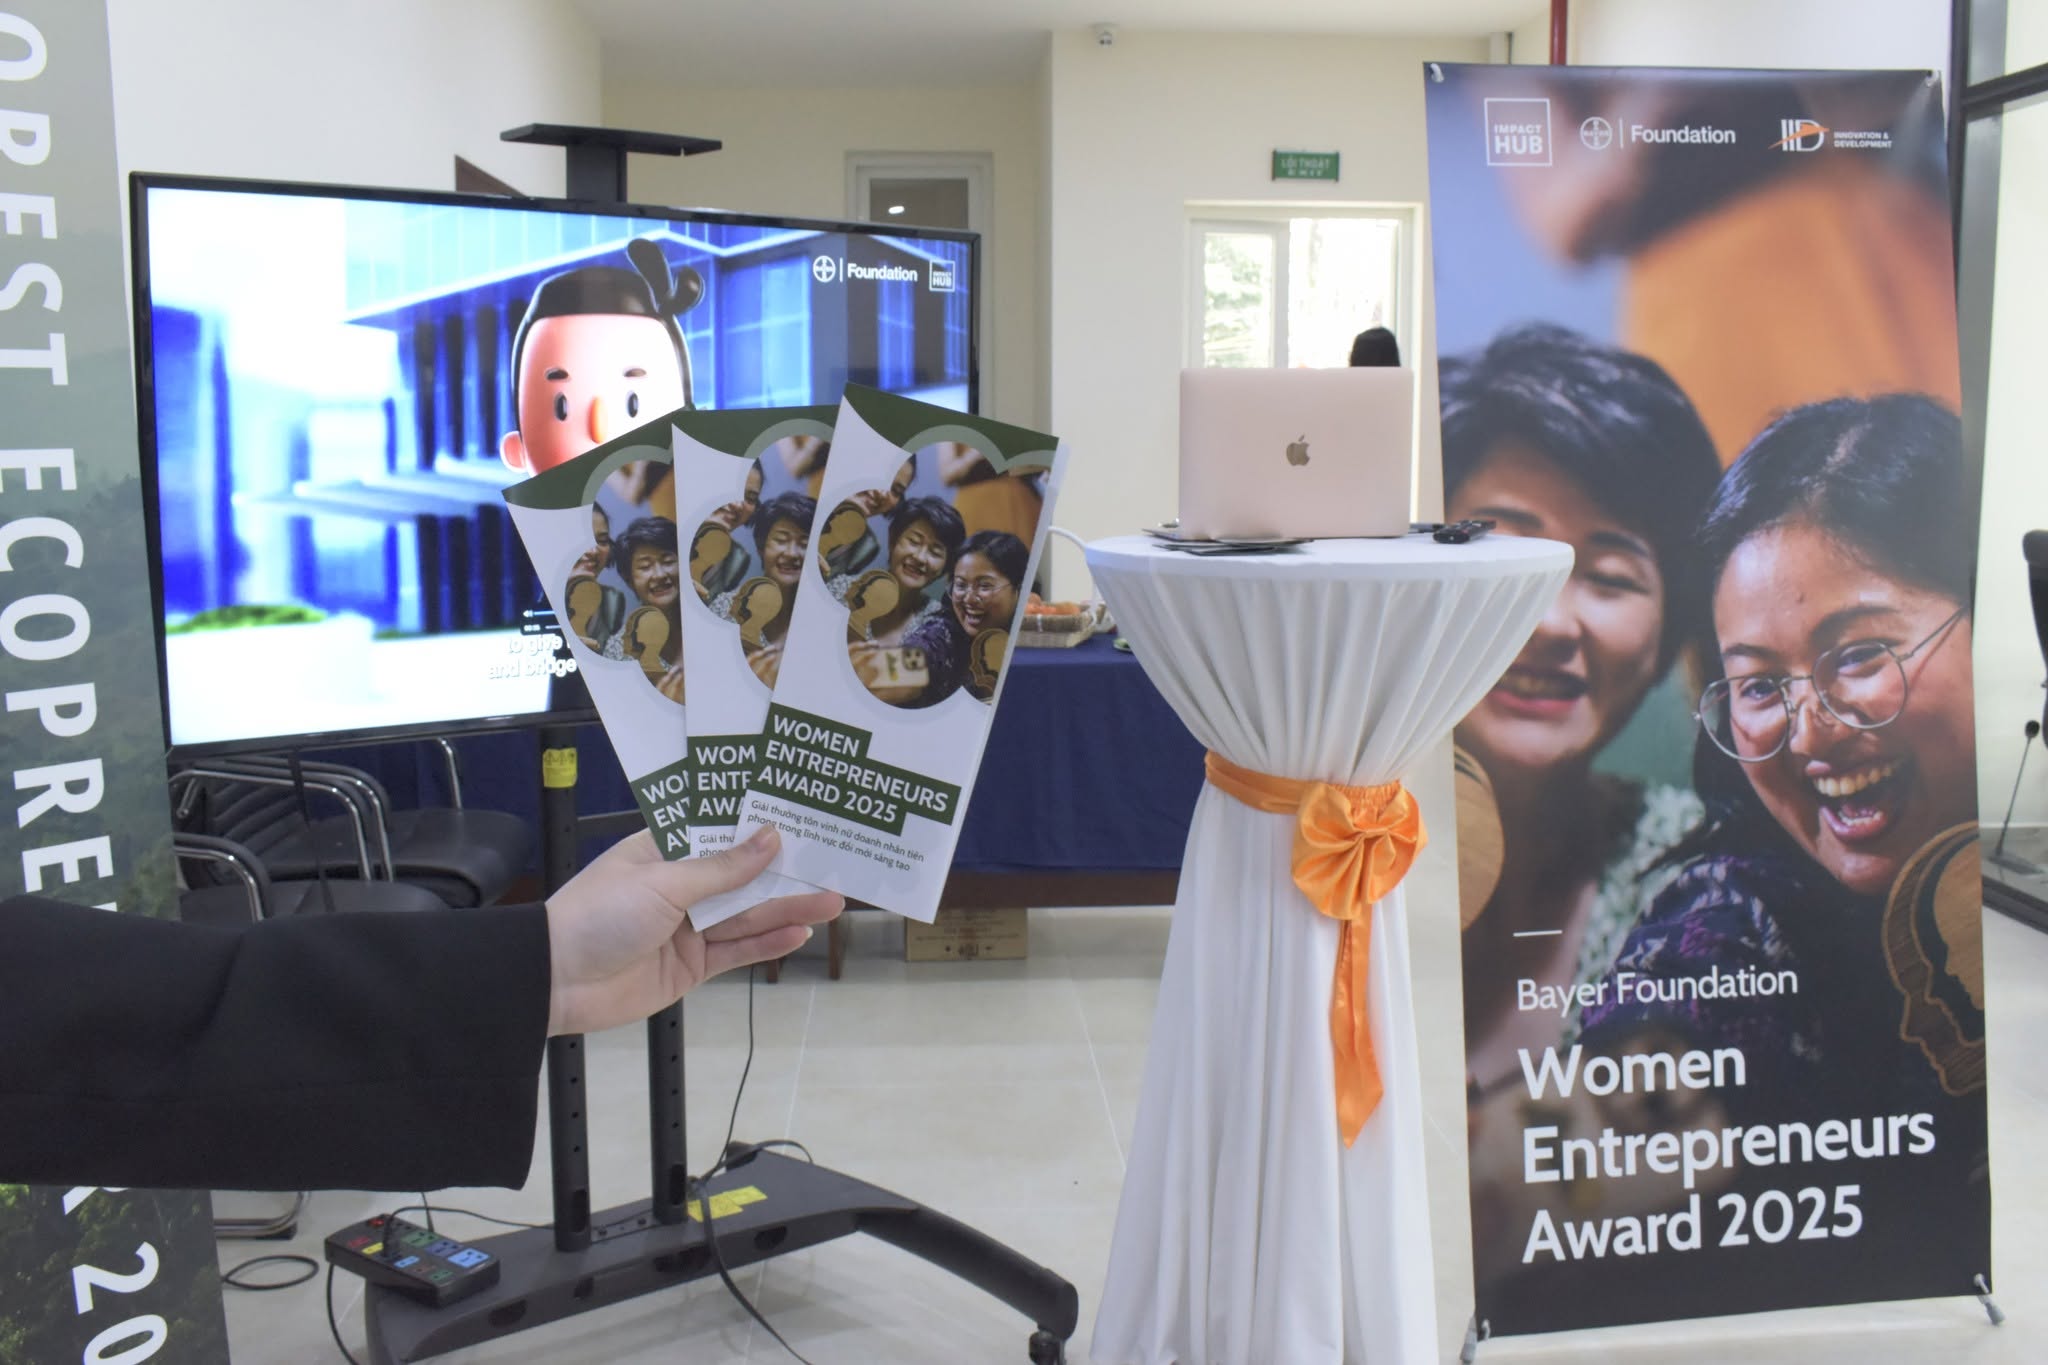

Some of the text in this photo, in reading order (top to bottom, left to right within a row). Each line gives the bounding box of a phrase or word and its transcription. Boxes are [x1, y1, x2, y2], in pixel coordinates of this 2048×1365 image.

[1494, 124, 1542, 134] IMPACT
[1630, 125, 1736, 144] Foundation
[1833, 131, 1881, 139] INNOVATION
[1495, 135, 1543, 154] HUB
[1833, 140, 1892, 149] DEVELOPMENT
[847, 263, 918, 282] Foundation
[932, 277, 952, 287] HUB
[527, 634, 563, 656] give
[488, 655, 577, 679] and bridge
[773, 714, 860, 758] WOMEN
[695, 745, 757, 766] WOM
[765, 739, 949, 812] ENTREPRENEURS
[757, 765, 841, 804] AWARD
[843, 790, 898, 823] 2025
[751, 800, 769, 812] Giải
[821, 822, 839, 834] vinh
[853, 832, 882, 848] doanh
[883, 842, 906, 856] nhân
[778, 822, 802, 838] trong
[1517, 965, 1799, 1018] Bayer Foundation
[1518, 1044, 1746, 1100] Women
[1523, 1112, 1936, 1189] Entrepreneurs
[1522, 1184, 1863, 1264] Award 2025
